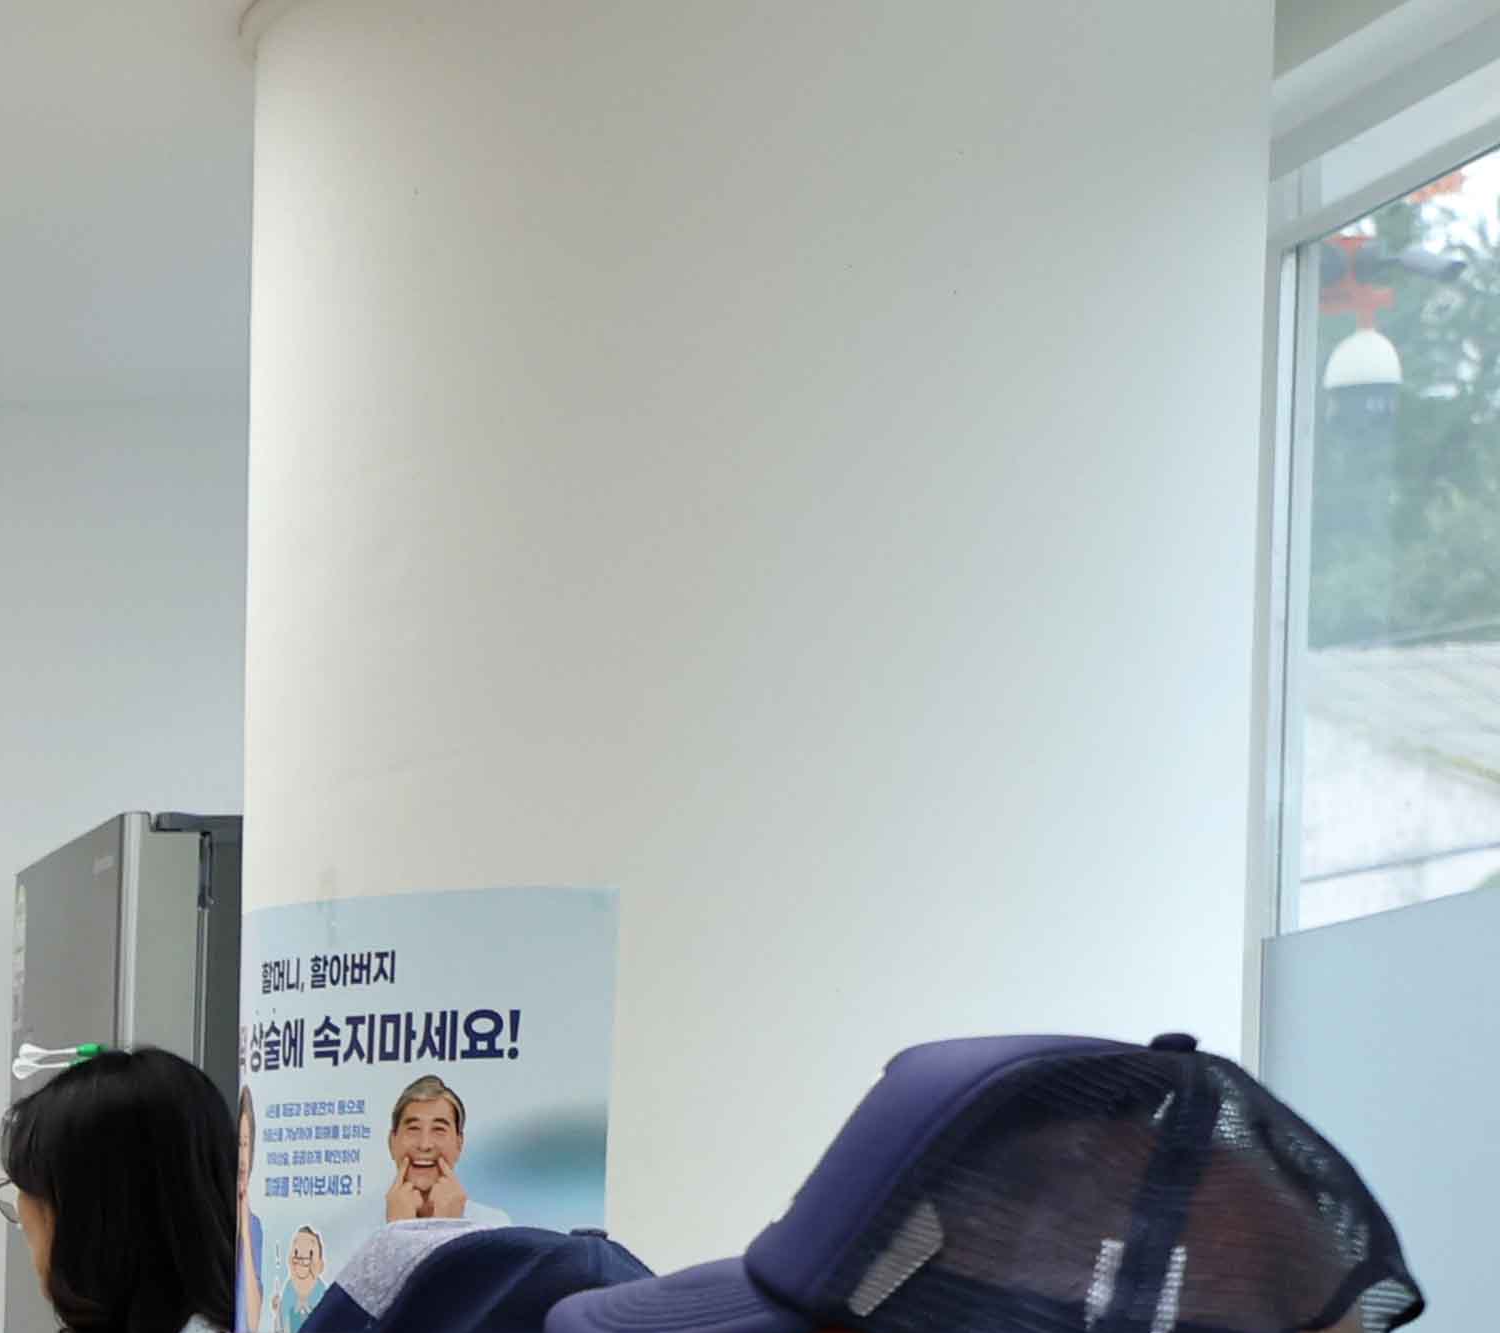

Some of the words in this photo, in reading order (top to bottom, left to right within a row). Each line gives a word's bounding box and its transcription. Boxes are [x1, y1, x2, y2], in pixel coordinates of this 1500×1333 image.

[261, 958, 305, 994] 할머니,
[310, 950, 396, 989] 할아버지
[250, 1017, 304, 1072] 상술에
[312, 1009, 521, 1067] 속지마세요!
[292, 1175, 352, 1197] 막아보세요
